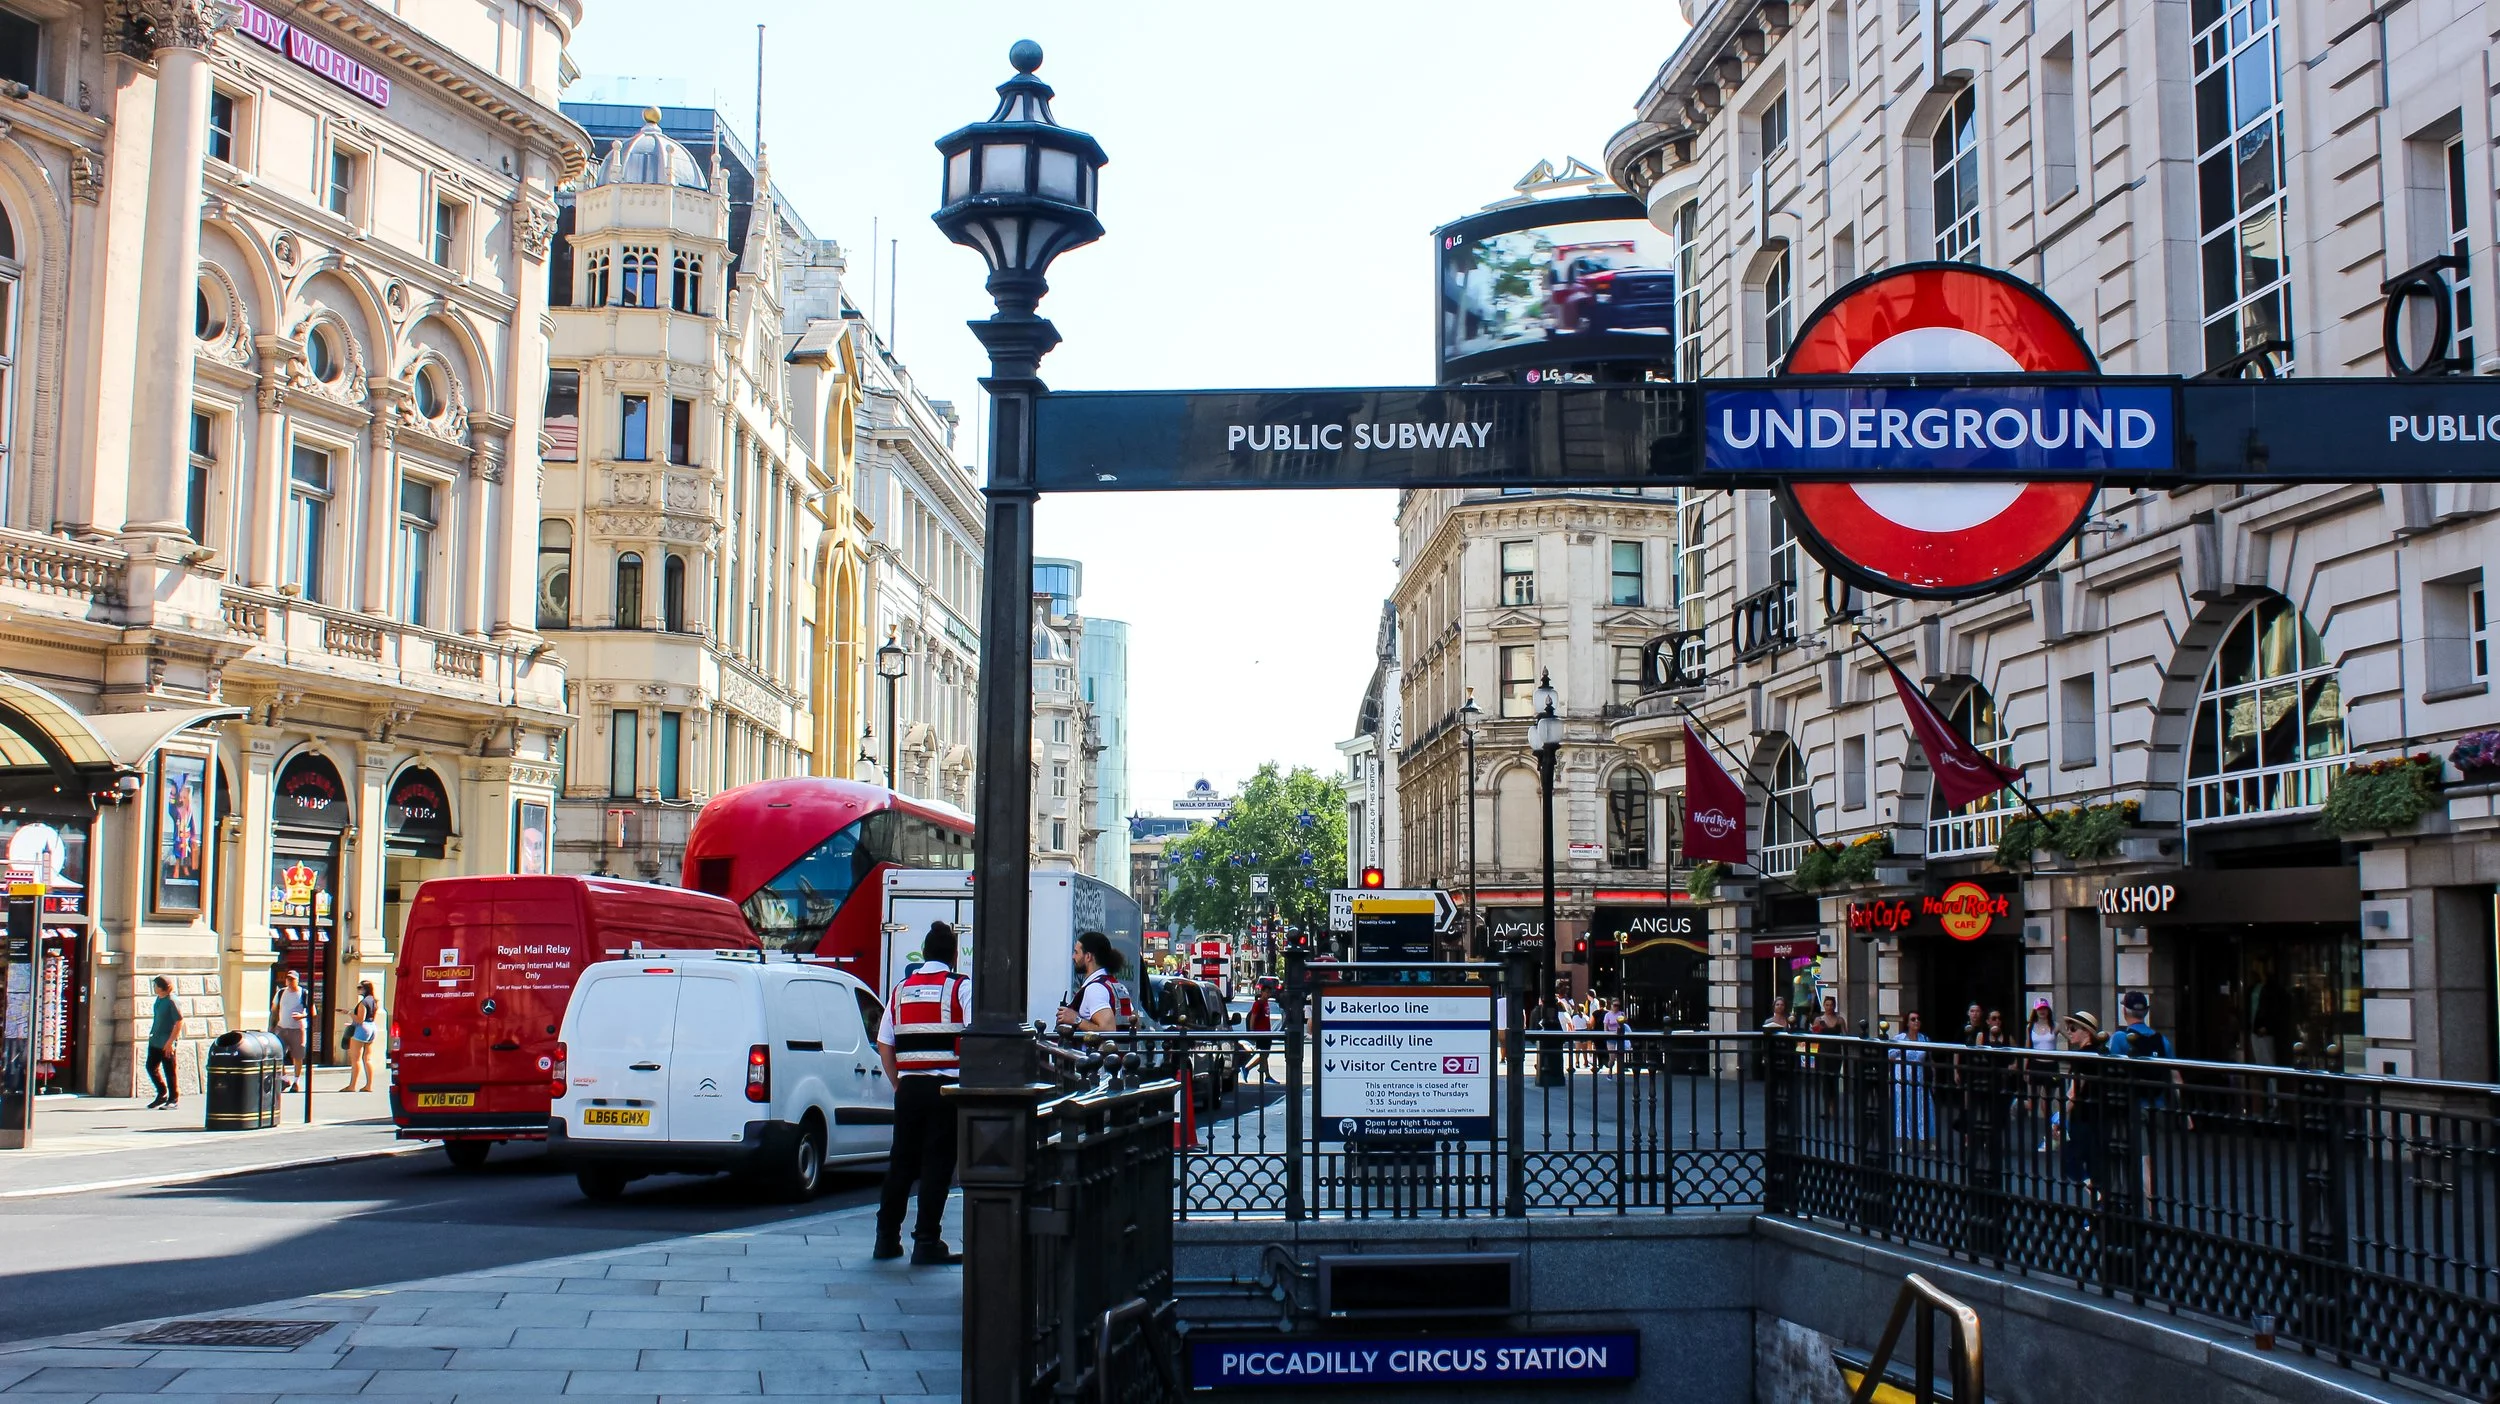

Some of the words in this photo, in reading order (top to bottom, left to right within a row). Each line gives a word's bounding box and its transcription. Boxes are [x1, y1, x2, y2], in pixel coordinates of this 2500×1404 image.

[230, 0, 287, 50] ODY
[290, 26, 389, 107] WORLDS
[1452, 235, 1462, 246] LG
[1723, 409, 2156, 448] UNDERGROUND
[1228, 424, 1343, 450] PUBLIC
[1354, 423, 1492, 449] SUBWAY
[1370, 808, 1375, 817] OF
[1694, 812, 1716, 824] Hard
[1717, 815, 1736, 829] Rock
[1334, 894, 1353, 902] The
[2098, 888, 2118, 913] OCK
[2121, 885, 2175, 912] SHOP
[1334, 905, 1352, 914] Tra
[1923, 895, 1962, 914] Hard
[1964, 894, 2008, 918] Rock
[1874, 900, 1911, 932] Cafe
[1630, 917, 1691, 933] ANGUS
[1954, 921, 1976, 929] CAFE
[497, 945, 521, 956] Royal
[524, 944, 542, 954] Mail
[546, 944, 571, 955] Relay
[497, 962, 525, 970] Carrying
[426, 968, 450, 979] Royal
[451, 968, 471, 977] Mail
[525, 972, 541, 980] Only
[421, 991, 475, 999] www.royalmail.com
[1340, 1002, 1399, 1014] Bakerloo
[1405, 1002, 1429, 1014] line
[1340, 1034, 1403, 1049] Piccadilly
[1408, 1034, 1433, 1047] line
[1340, 1059, 1385, 1072] Visitor
[1390, 1060, 1437, 1072] Centre
[423, 1094, 446, 1105] KV18
[449, 1094, 468, 1105] WGD
[1388, 1090, 1420, 1098] Mondays
[1433, 1090, 1469, 1098] Thursdays
[588, 1110, 618, 1124] LB66
[621, 1110, 644, 1123] GMX
[1400, 1119, 1420, 1127] Night
[1404, 1127, 1435, 1135] Saturday
[1437, 1127, 1460, 1135] nights
[1222, 1351, 1378, 1375] PICCADILLY
[1388, 1349, 1487, 1373] CIRCUS
[1496, 1347, 1607, 1371] STATION
